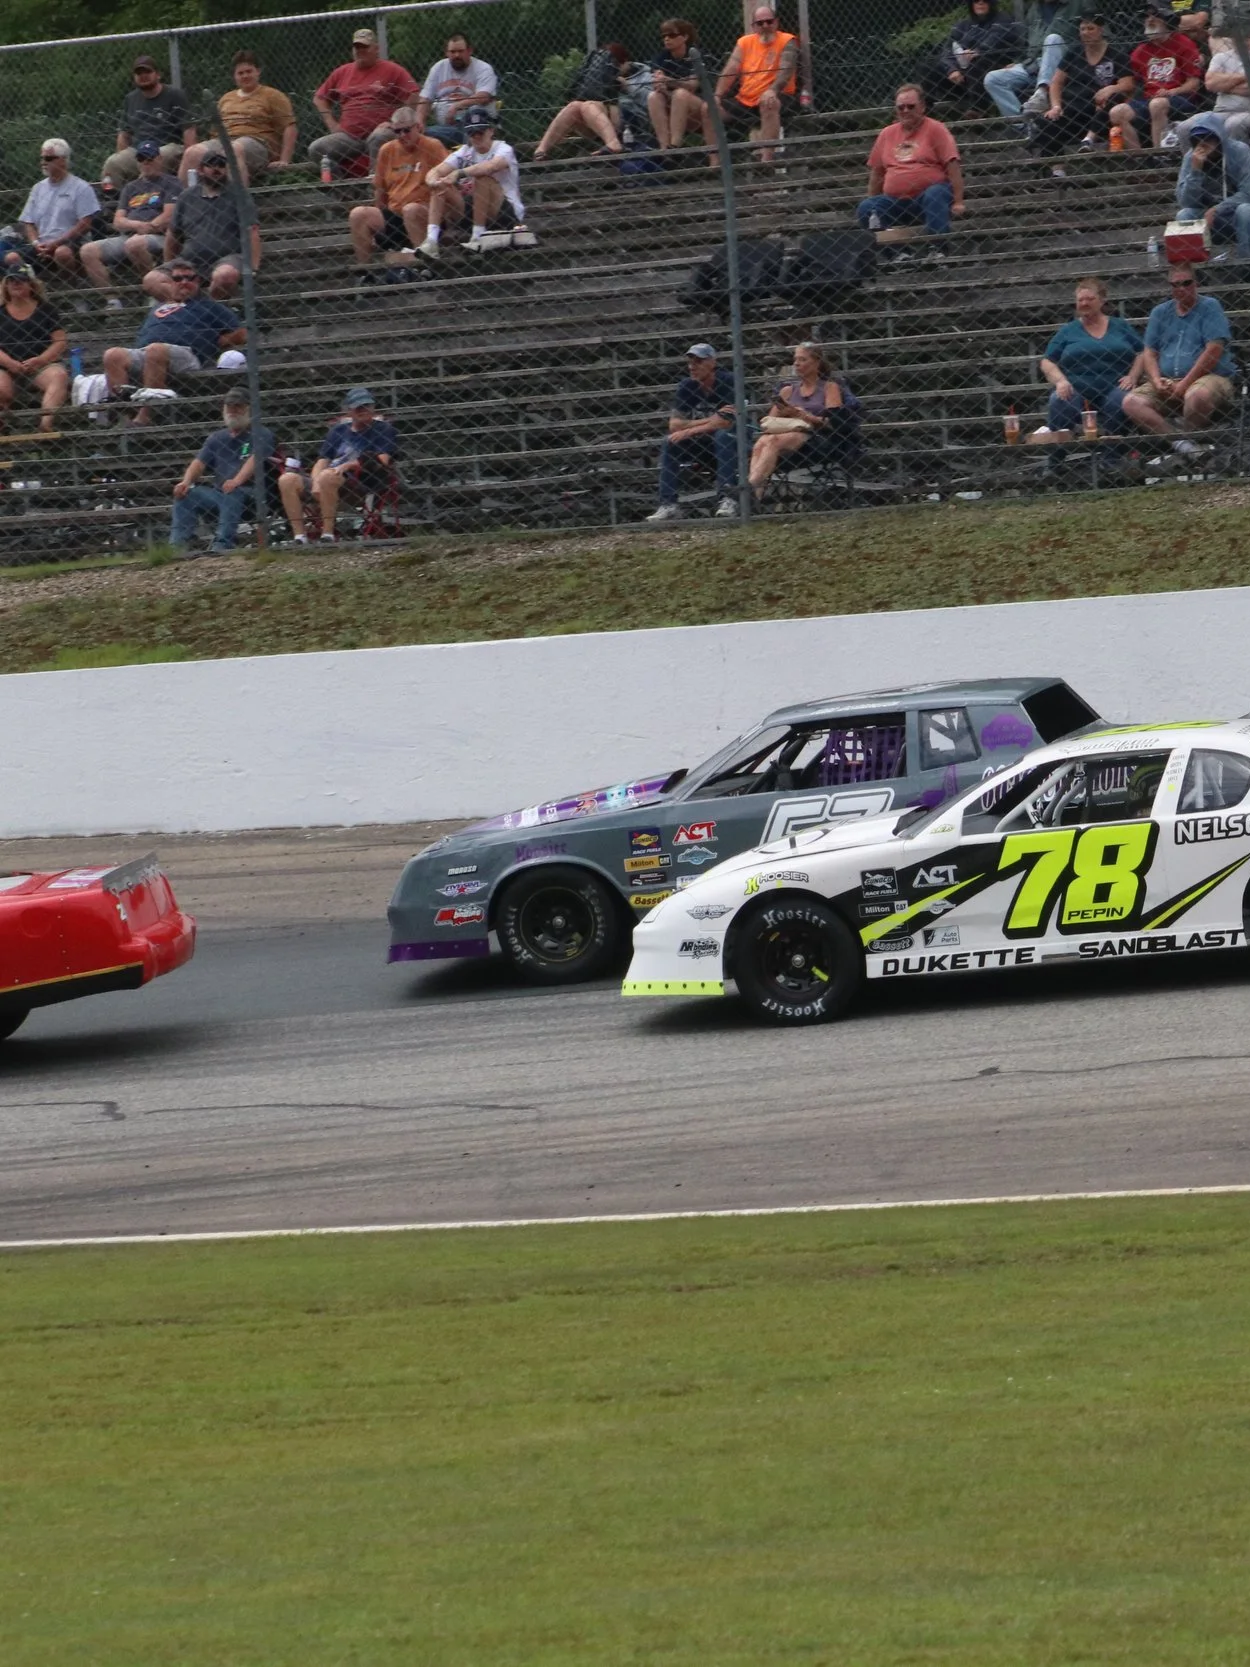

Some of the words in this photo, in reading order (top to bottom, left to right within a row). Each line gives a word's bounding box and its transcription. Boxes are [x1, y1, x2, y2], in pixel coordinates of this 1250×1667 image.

[673, 821, 716, 843] ACT
[631, 859, 654, 868] Milton
[760, 871, 809, 884] HOOSIER
[866, 876, 892, 885] SUNOCO
[912, 865, 958, 887] ACT
[998, 820, 1156, 935] 78
[881, 888, 897, 896] FUELS
[580, 884, 605, 944] Hoosier
[865, 906, 890, 914] Milton
[896, 903, 906, 911] CAT
[1068, 906, 1124, 921] PEPIN
[763, 909, 827, 929] Hoosier
[506, 907, 534, 964] Hoosier
[882, 946, 1036, 976] DUKETTE
[1078, 929, 1245, 959] SANDBLAST
[762, 998, 826, 1017] Hoosier
